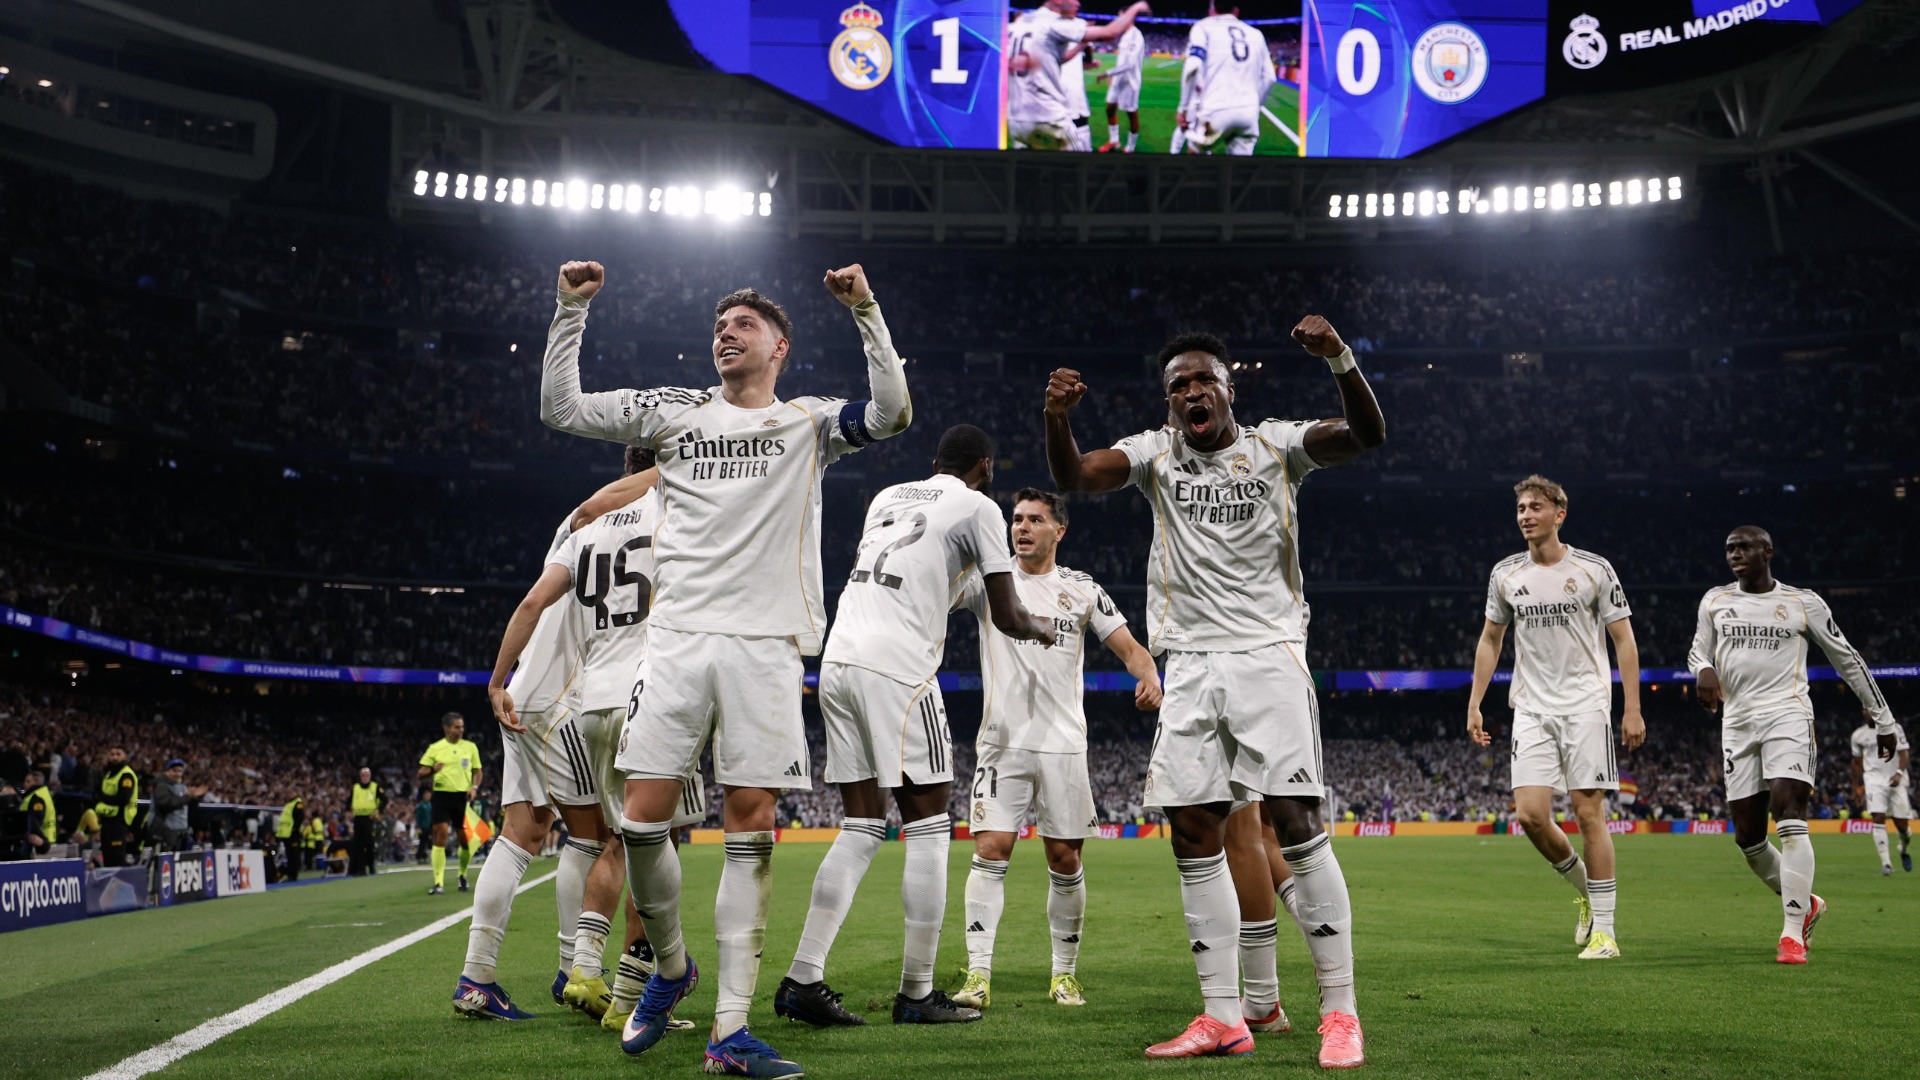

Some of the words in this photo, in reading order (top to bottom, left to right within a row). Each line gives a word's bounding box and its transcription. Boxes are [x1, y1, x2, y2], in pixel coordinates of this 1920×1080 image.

[1620, 26, 1681, 52] REAL
[1683, 0, 1768, 40] MADRID
[931, 17, 969, 84] 1
[1228, 26, 1249, 62] 8
[1336, 28, 1381, 96] 0
[679, 435, 785, 460] Emirates
[693, 462, 715, 480] FLY
[719, 460, 768, 479] BETTER
[890, 485, 943, 501] RÜDIGER
[1175, 480, 1266, 504] Emirates
[1189, 505, 1207, 522] FLY
[1209, 502, 1254, 523] BETTER
[576, 536, 652, 630] 45
[1517, 602, 1578, 617] Emirates
[1526, 618, 1539, 629] FLY
[1542, 615, 1570, 627] BETTER
[1722, 623, 1791, 639] Emirates
[1731, 638, 1746, 649] FLY
[1748, 638, 1780, 651] BETTER
[627, 679, 644, 722] 8
[973, 766, 998, 799] 21
[174, 860, 203, 894] PEPSI
[228, 854, 252, 891] FedEx
[1, 873, 81, 918] crypto.com
